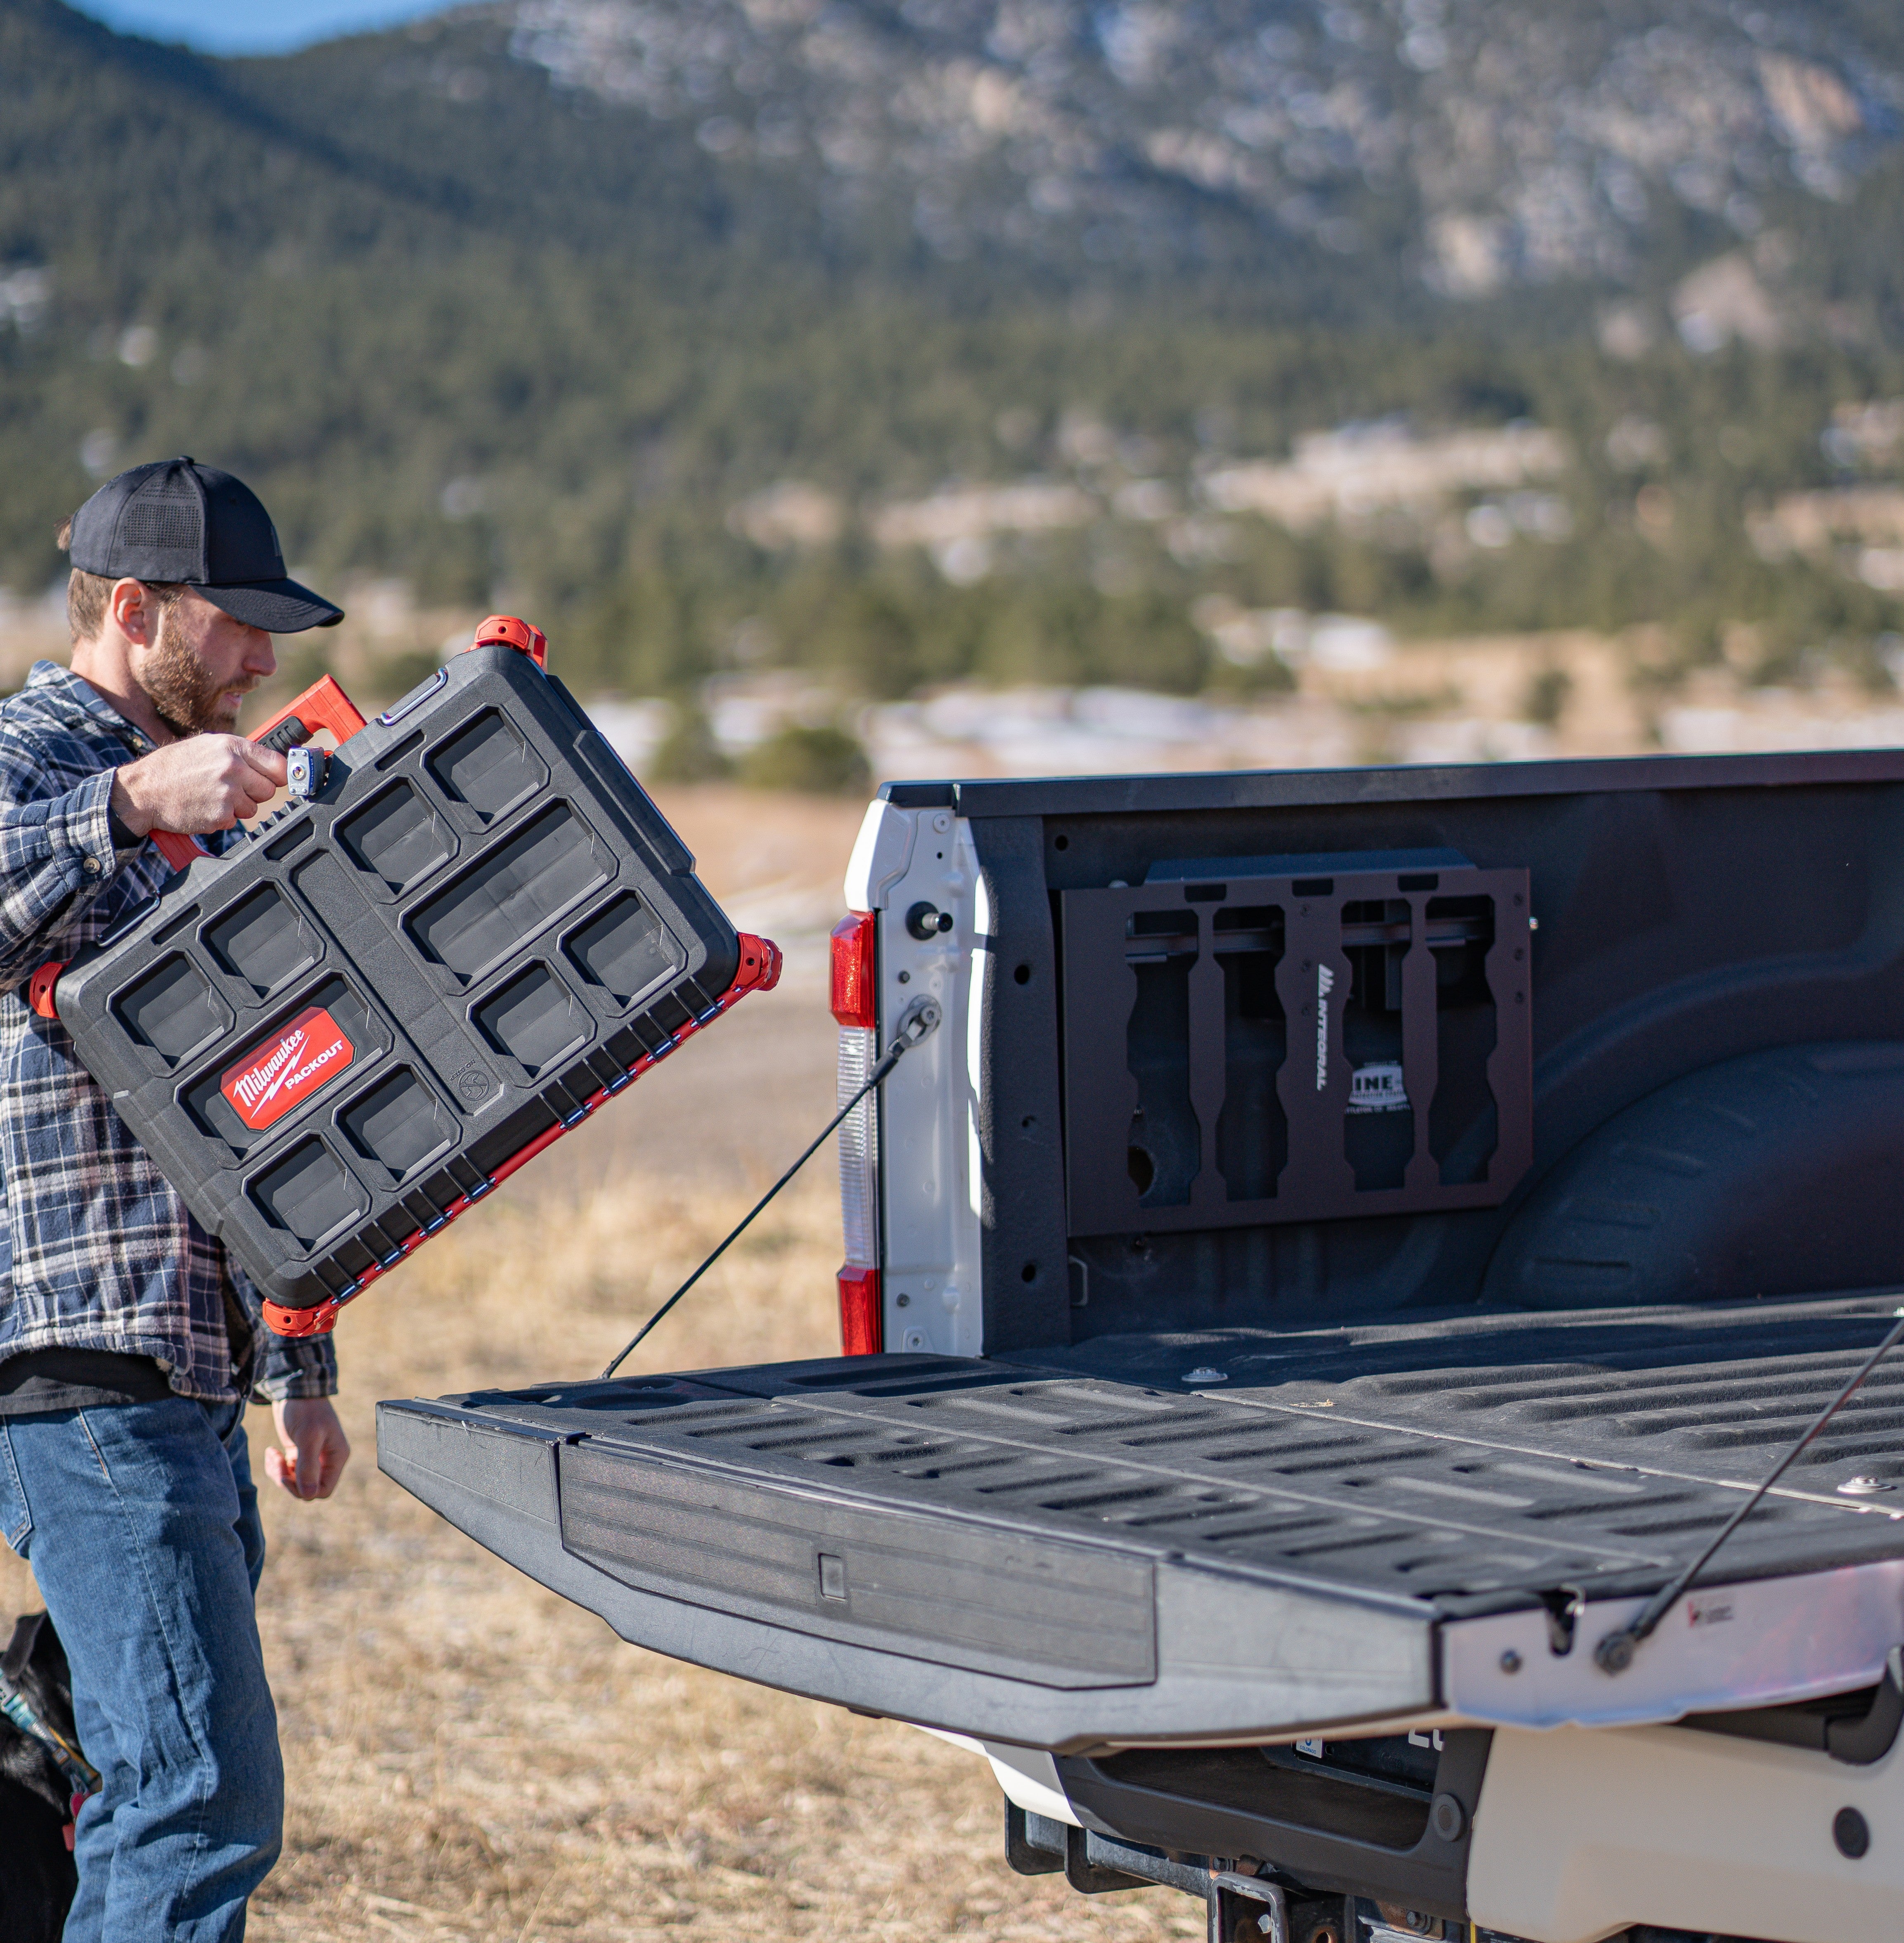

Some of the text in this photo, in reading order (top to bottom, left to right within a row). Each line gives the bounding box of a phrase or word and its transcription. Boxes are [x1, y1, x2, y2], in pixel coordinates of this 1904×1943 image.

[233, 1029, 305, 1107] Milwaukee
[284, 1039, 344, 1089] PACKOUT
[1317, 999, 1328, 1091] INTEGRAL
[450, 1067, 465, 1081] STEP
[1300, 1745, 1316, 1754] COLORADO
